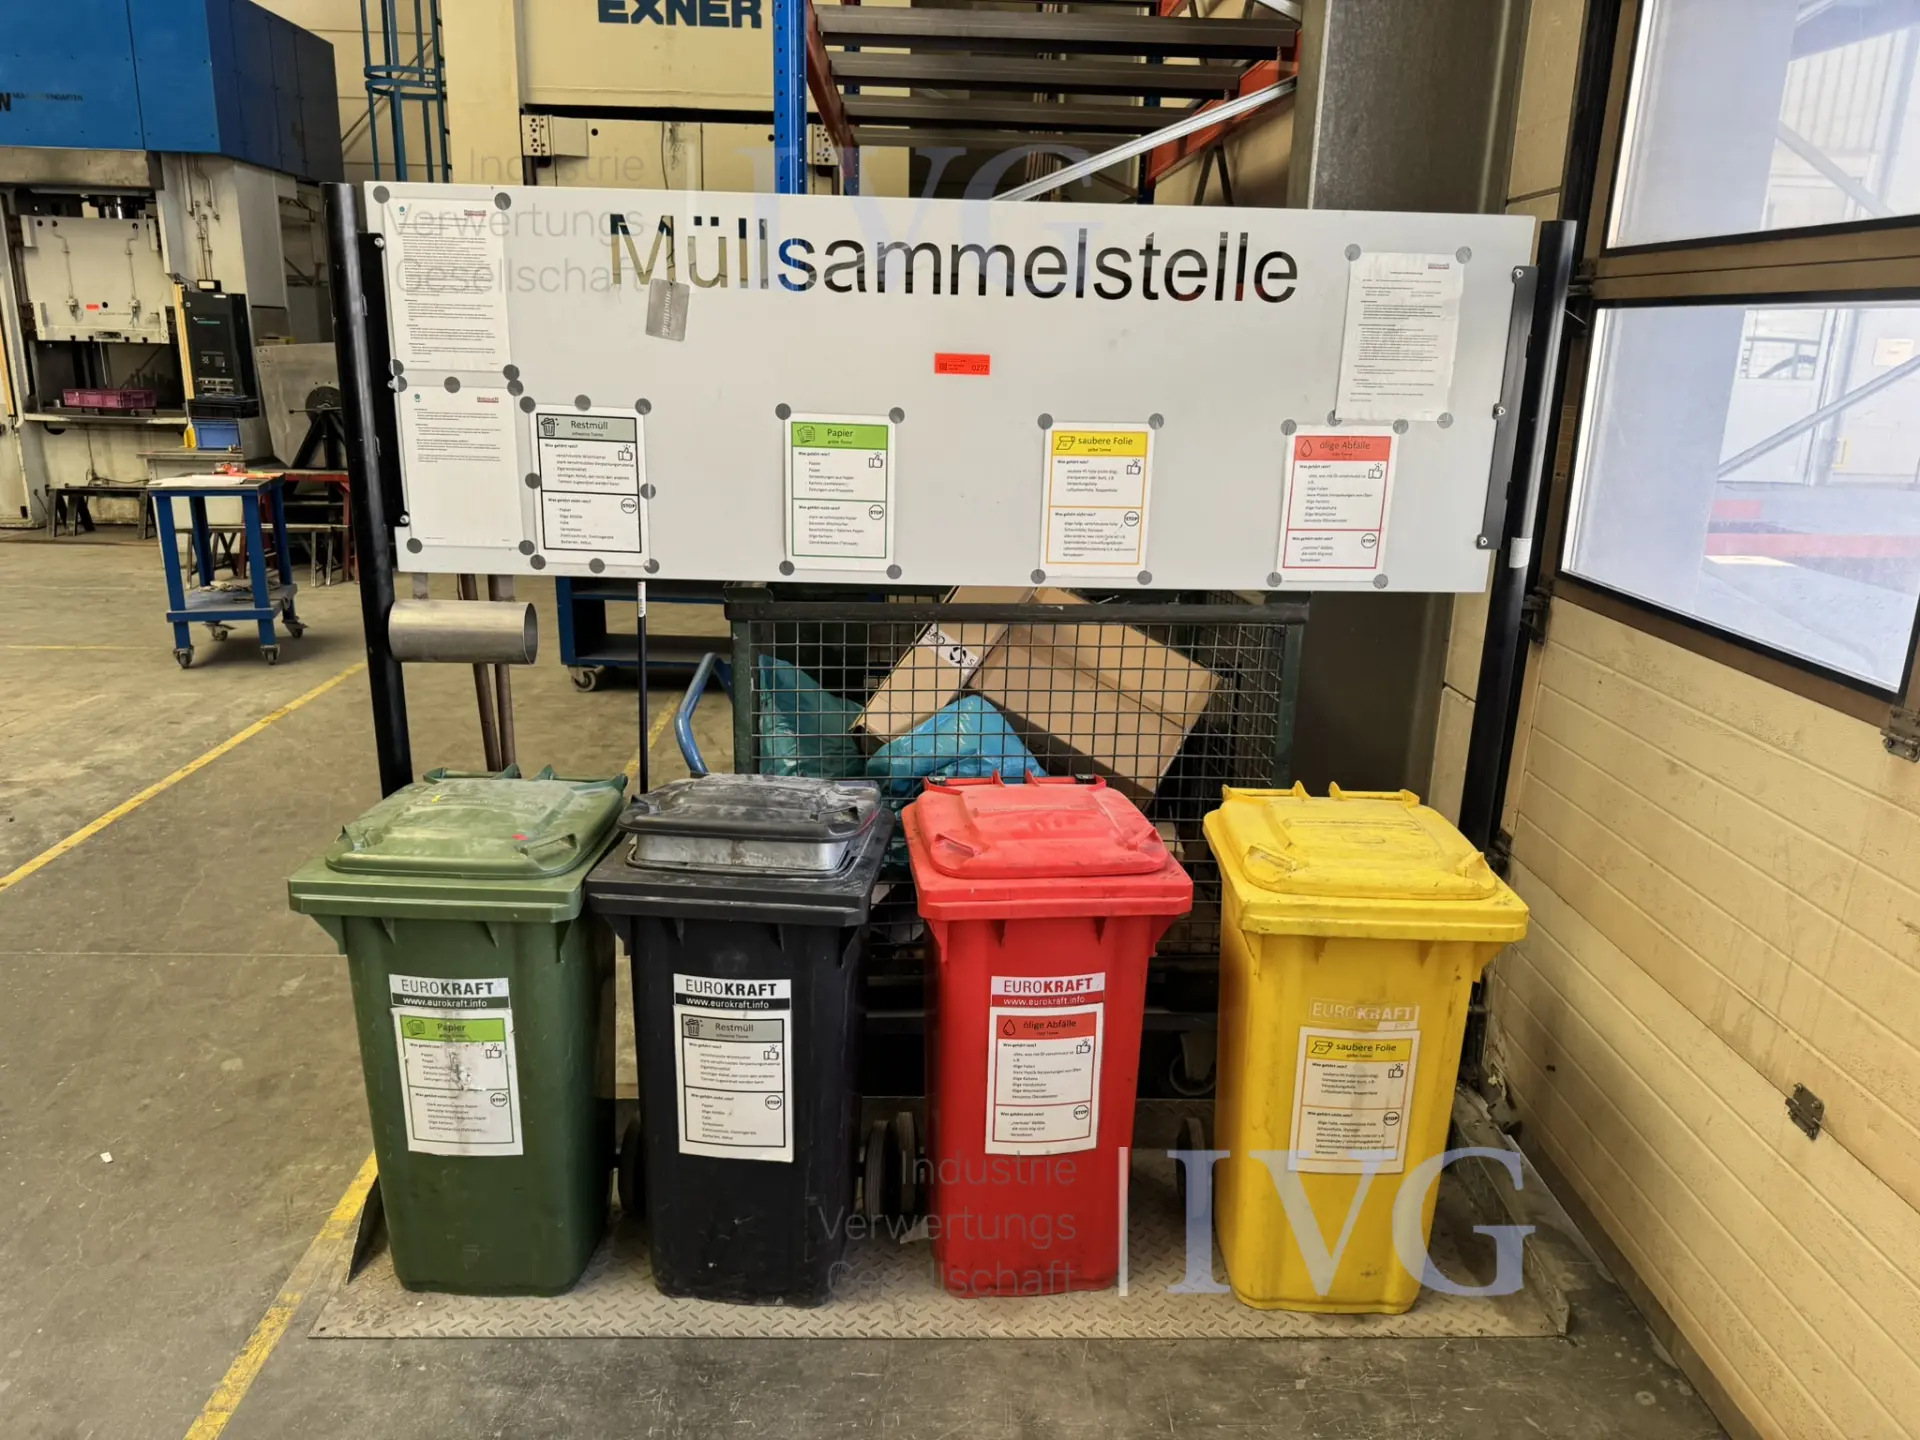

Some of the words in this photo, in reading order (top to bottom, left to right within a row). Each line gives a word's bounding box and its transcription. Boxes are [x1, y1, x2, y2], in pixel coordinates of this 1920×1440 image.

[598, 0, 762, 28] EXNER
[610, 213, 1299, 303] Müllsammelstelle
[570, 420, 609, 430] Restmüll
[827, 428, 854, 438] Papier
[1078, 437, 1111, 445] saubere
[1113, 437, 1133, 446] Folie
[1320, 441, 1340, 451] ölige
[1341, 440, 1370, 450] Abfälle
[401, 979, 494, 996] EUROKRAFT
[686, 979, 777, 996] EUROKRAFT
[1004, 978, 1093, 993] EUROKRAFT
[403, 998, 488, 1008] www.eurokraft.info
[686, 997, 770, 1009] www.eurokraft.info
[1003, 996, 1085, 1006] www.eurokraft.info
[1312, 1002, 1414, 1020] EUROKRAFT
[437, 1023, 466, 1032] Papier
[715, 1022, 754, 1032] Restmüll
[1023, 1021, 1045, 1030] ölige
[1046, 1020, 1077, 1028] Abfälle
[1336, 1043, 1373, 1052] saubere
[1375, 1044, 1397, 1052] Folie
